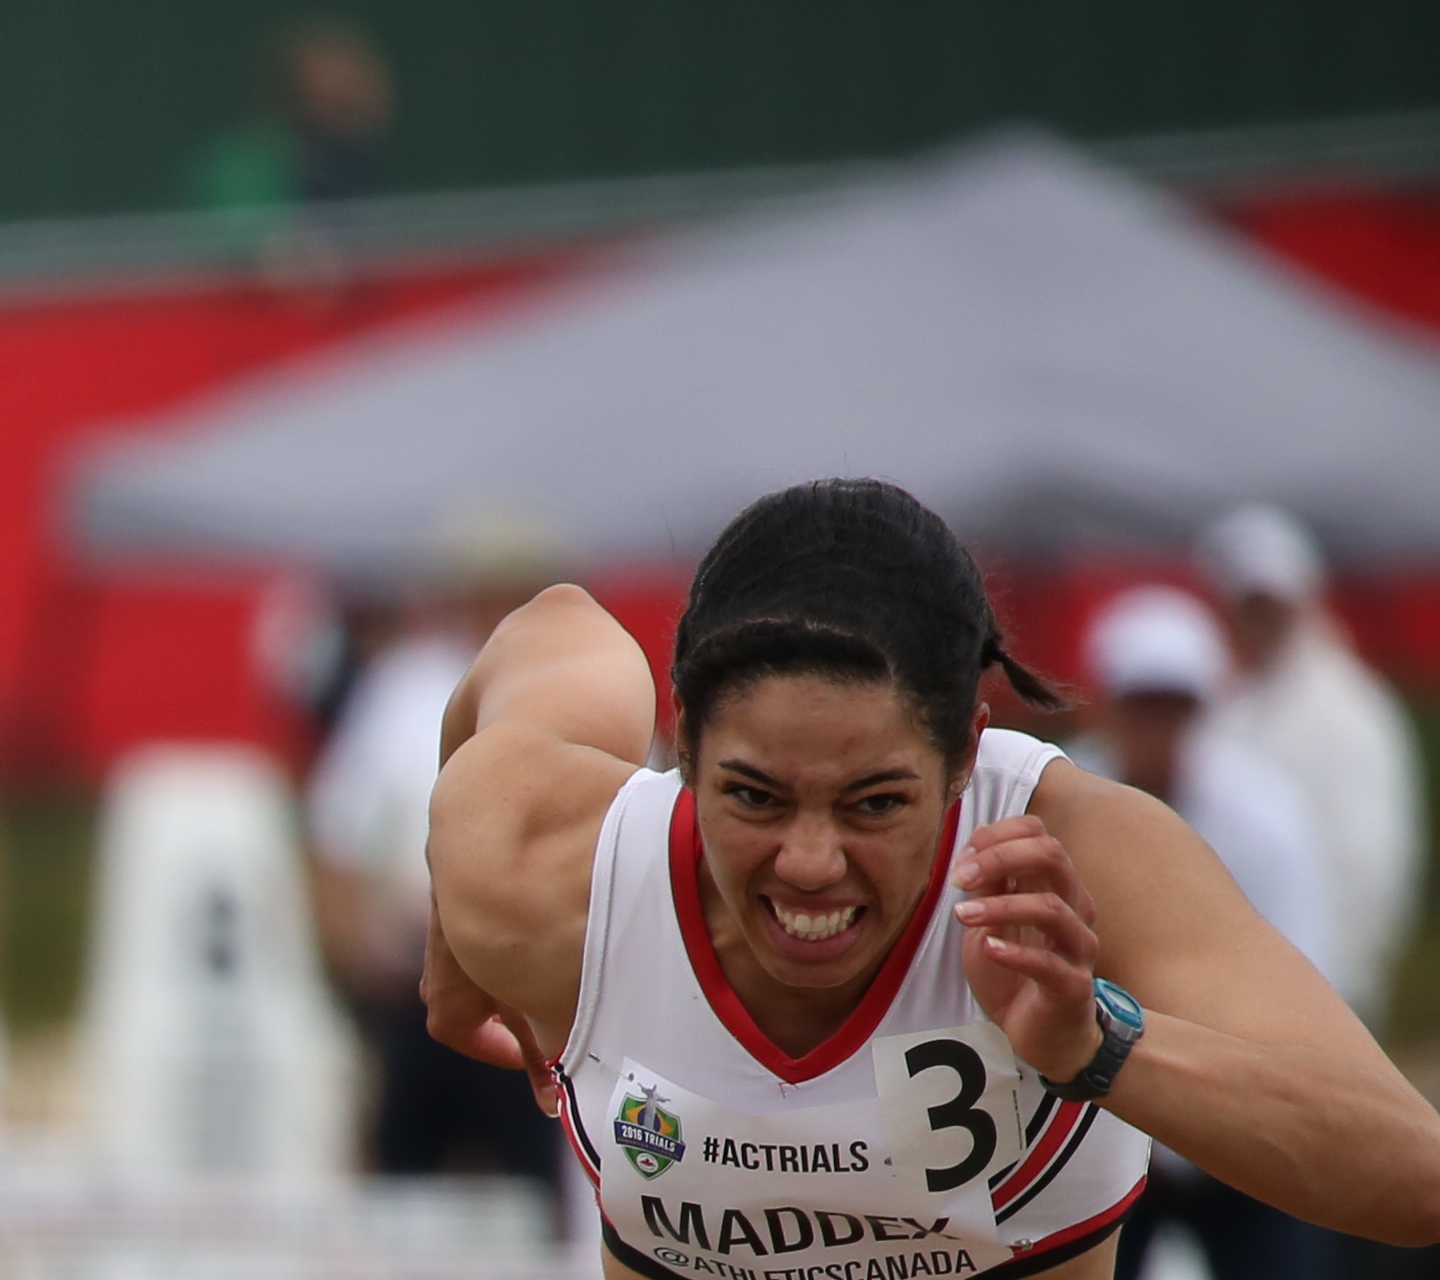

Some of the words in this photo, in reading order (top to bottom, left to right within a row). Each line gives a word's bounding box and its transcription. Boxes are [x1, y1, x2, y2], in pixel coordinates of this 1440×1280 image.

[904, 1038, 997, 1192] 3
[644, 1131, 677, 1153] TRIALS
[703, 1136, 869, 1173] #ACTRIALS
[641, 1195, 961, 1257] MADDEX
